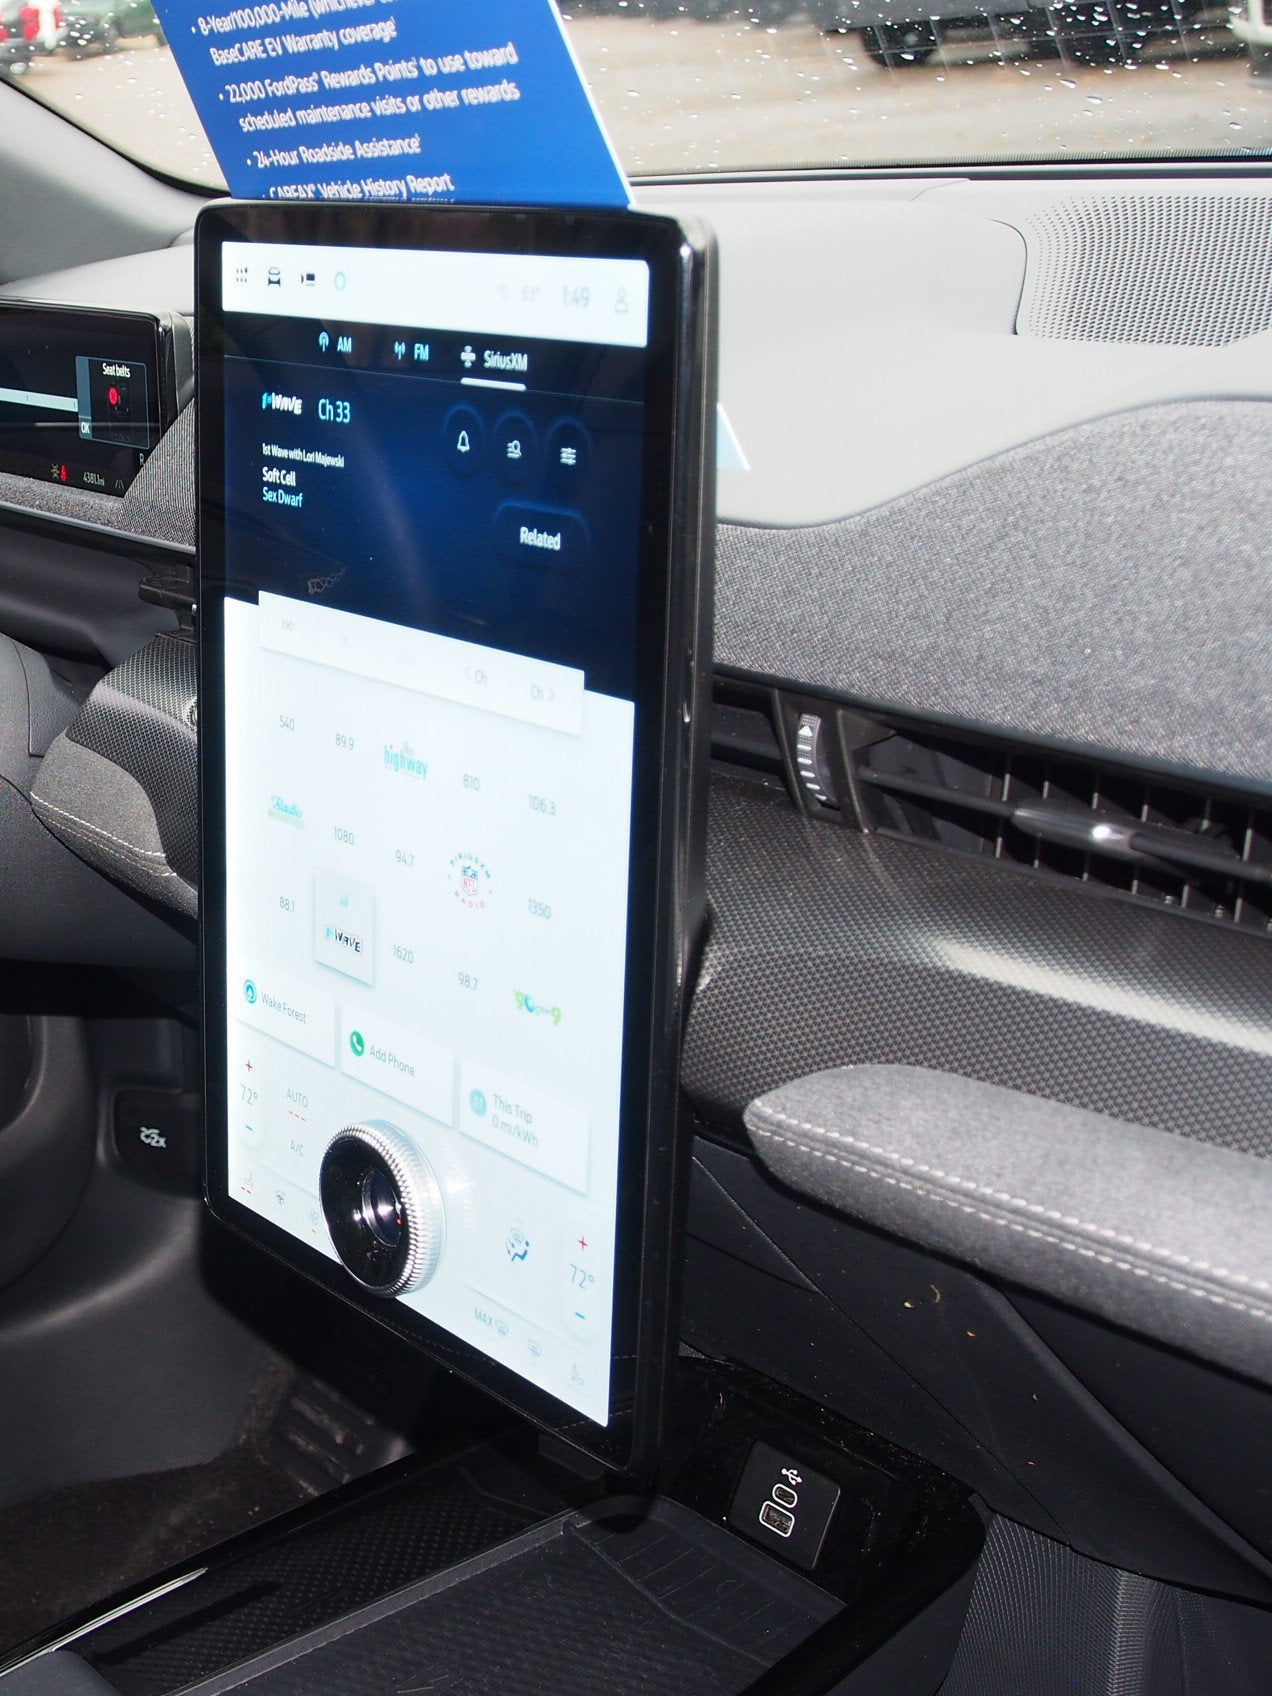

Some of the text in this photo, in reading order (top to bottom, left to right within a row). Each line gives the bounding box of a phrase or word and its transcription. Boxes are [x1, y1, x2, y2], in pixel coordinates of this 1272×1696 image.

[210, 39, 266, 66] BaseCARE
[265, 37, 282, 57] EV
[282, 29, 338, 51] Warranty
[225, 80, 265, 104] 22,000
[321, 64, 376, 90] Rewards
[419, 56, 437, 76] to
[437, 54, 466, 74] use
[464, 41, 519, 70] toward
[239, 78, 520, 132] scheduled maintenance visits or other rewards
[253, 148, 300, 168] 24-Hour
[299, 141, 355, 164] Roadside
[317, 180, 363, 199] Vehicle
[361, 178, 407, 199] History
[406, 172, 455, 195] Report
[563, 285, 590, 308] 1:49
[337, 336, 352, 353] AM
[414, 343, 429, 361] FM
[102, 362, 131, 378] Seat belts
[484, 349, 528, 372] SiriusXM
[318, 398, 350, 423] Ch 33
[80, 421, 90, 434] OK
[262, 442, 270, 455] 1st
[271, 444, 288, 459] Wave
[289, 447, 303, 460] with
[303, 449, 315, 463] Lori
[262, 466, 296, 487] Soft Cell
[262, 486, 303, 508] Sex Dwarf
[520, 526, 561, 551] Related
[335, 733, 354, 750] 89.9
[384, 744, 428, 780] highway
[463, 774, 480, 791] 810
[528, 793, 556, 816] 106.3
[395, 850, 415, 868] 94.7
[392, 944, 414, 963] 1620
[458, 972, 479, 991] 98.7
[262, 993, 307, 1024] Wake Forest
[370, 1045, 415, 1076] Add Phone
[287, 1088, 308, 1108] AUTO
[492, 1093, 532, 1124] This Trip
[492, 1114, 499, 1128] 0
[290, 1140, 304, 1157] A/C
[474, 1307, 493, 1328] MAX
